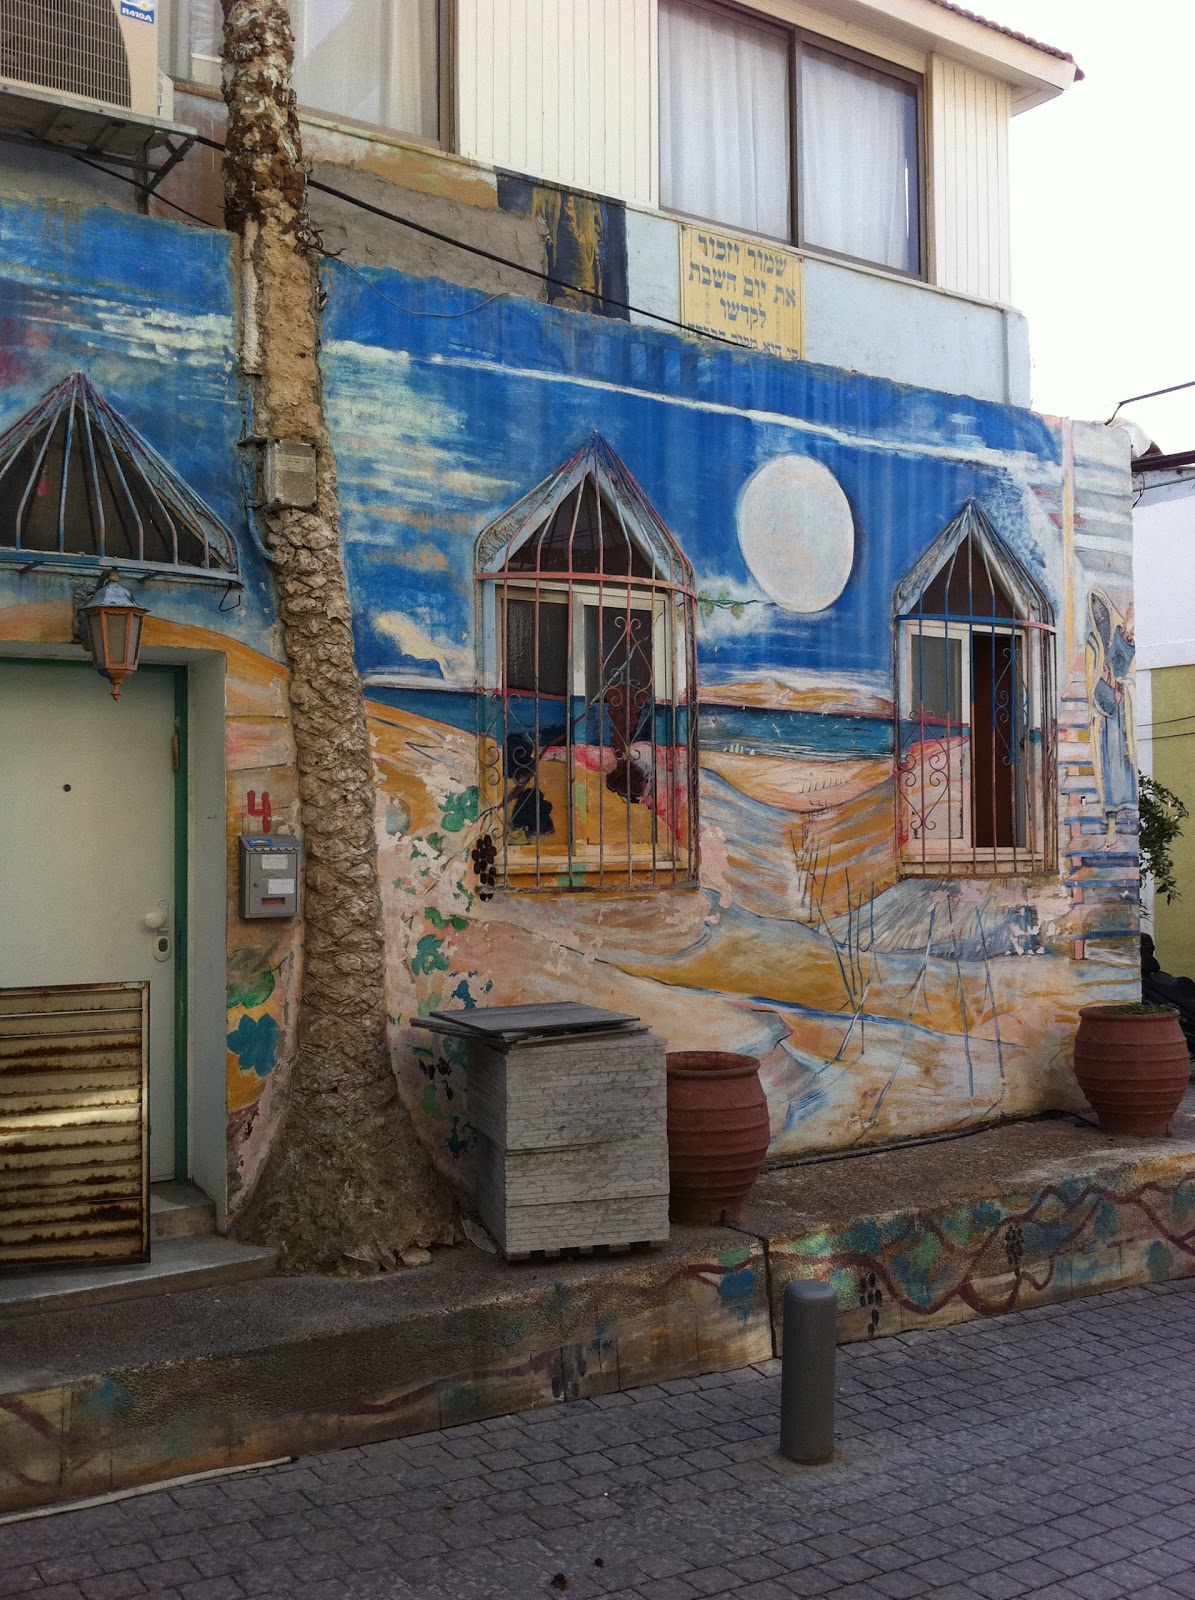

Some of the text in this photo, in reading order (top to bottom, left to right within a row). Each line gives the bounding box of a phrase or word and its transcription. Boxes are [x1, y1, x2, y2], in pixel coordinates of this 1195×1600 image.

[122, 7, 152, 22] R410A
[697, 233, 788, 277] שמור וזכור
[688, 261, 796, 308] את יום השבת
[719, 297, 767, 330] לקדשו
[247, 790, 271, 833] 4
